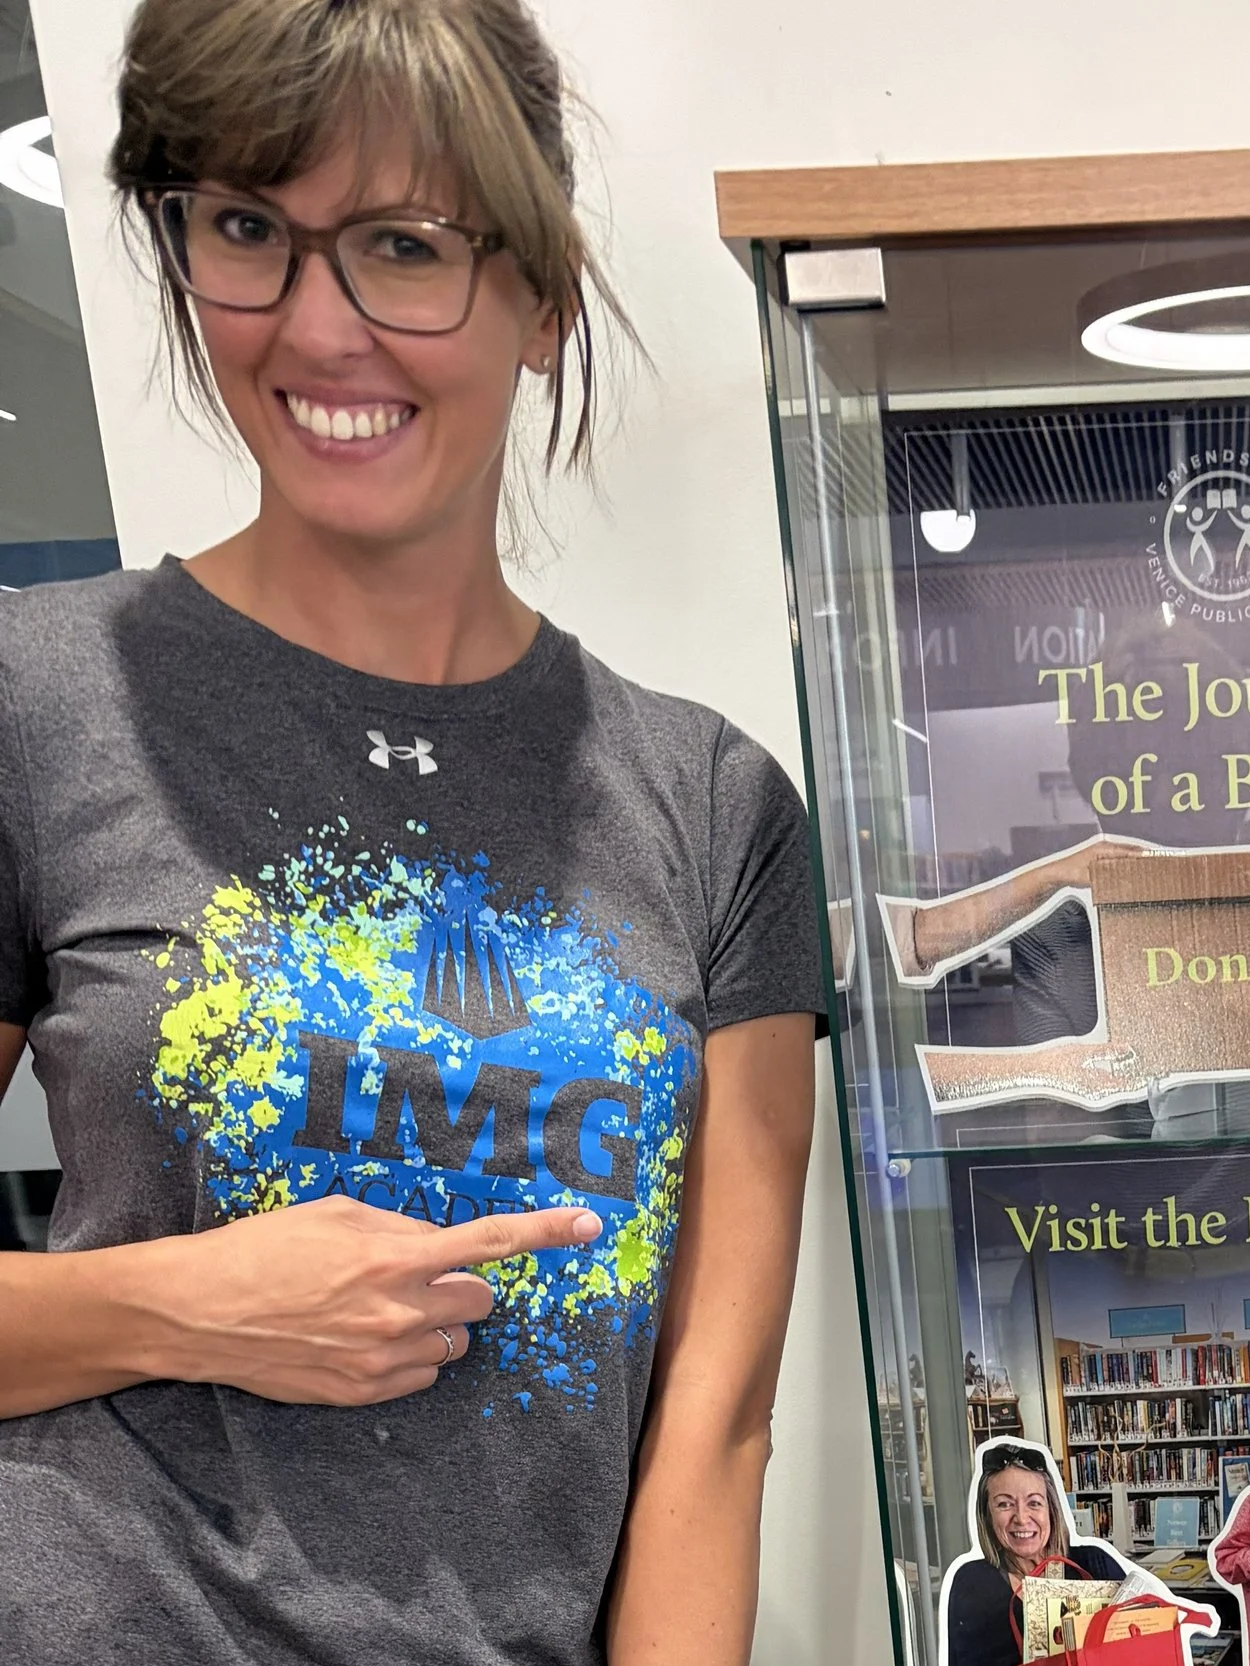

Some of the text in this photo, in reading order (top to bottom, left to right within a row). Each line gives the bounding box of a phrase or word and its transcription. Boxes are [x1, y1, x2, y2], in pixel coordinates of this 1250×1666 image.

[1157, 449, 1250, 497] FRIENDS
[1145, 543, 1186, 609] VENICE
[1038, 662, 1164, 727] The
[1090, 751, 1160, 818] of
[1171, 767, 1204, 810] a
[290, 1030, 642, 1203] IMG
[1003, 1201, 1127, 1254] Visit
[1140, 1193, 1227, 1248] the
